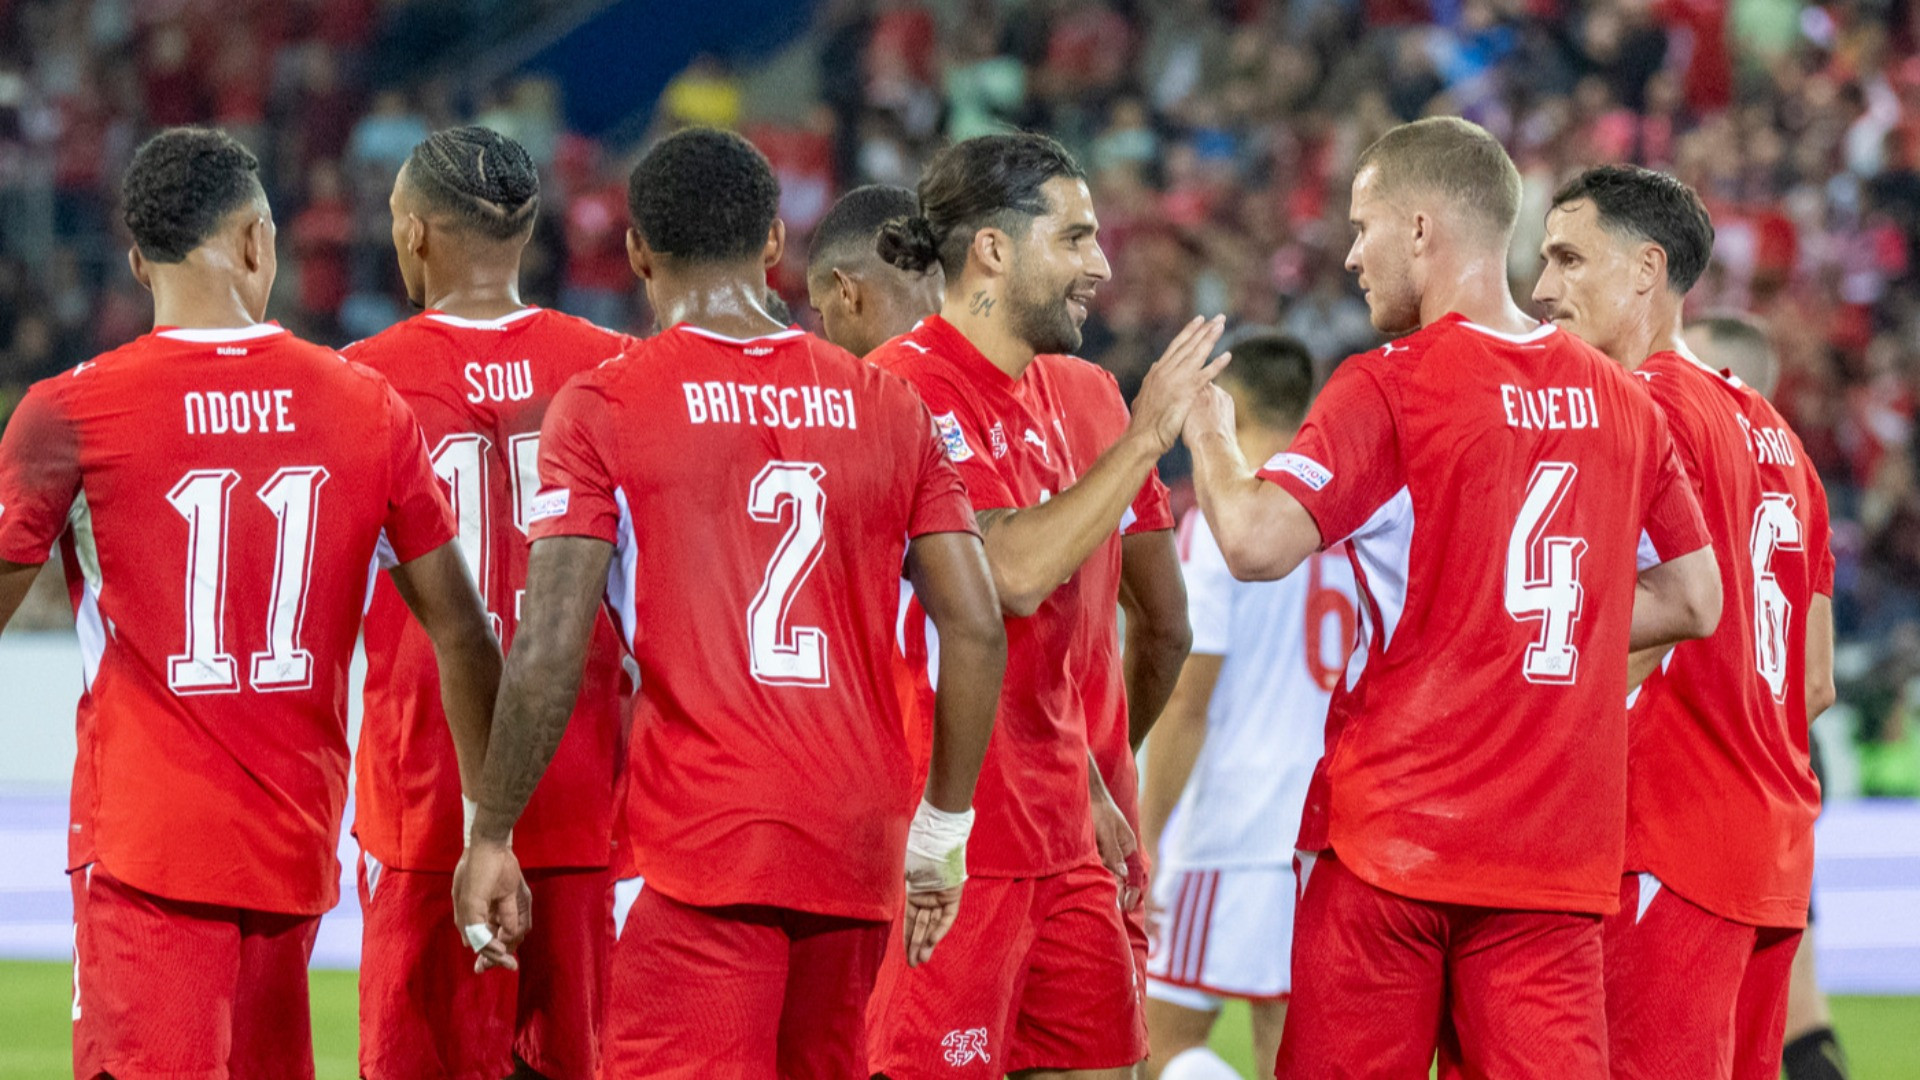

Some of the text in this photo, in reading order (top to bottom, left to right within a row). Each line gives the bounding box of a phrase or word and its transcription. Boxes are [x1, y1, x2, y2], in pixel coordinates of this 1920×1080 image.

[184, 389, 296, 435] NDOYE
[216, 346, 248, 356] suisse
[465, 360, 534, 404] SOW
[683, 382, 857, 430] BRITSCHGI
[166, 466, 330, 695] 11
[747, 460, 830, 688] 2
[1304, 544, 1357, 693] 6
[1504, 462, 1588, 685] 4
[1750, 491, 1805, 705] 6
